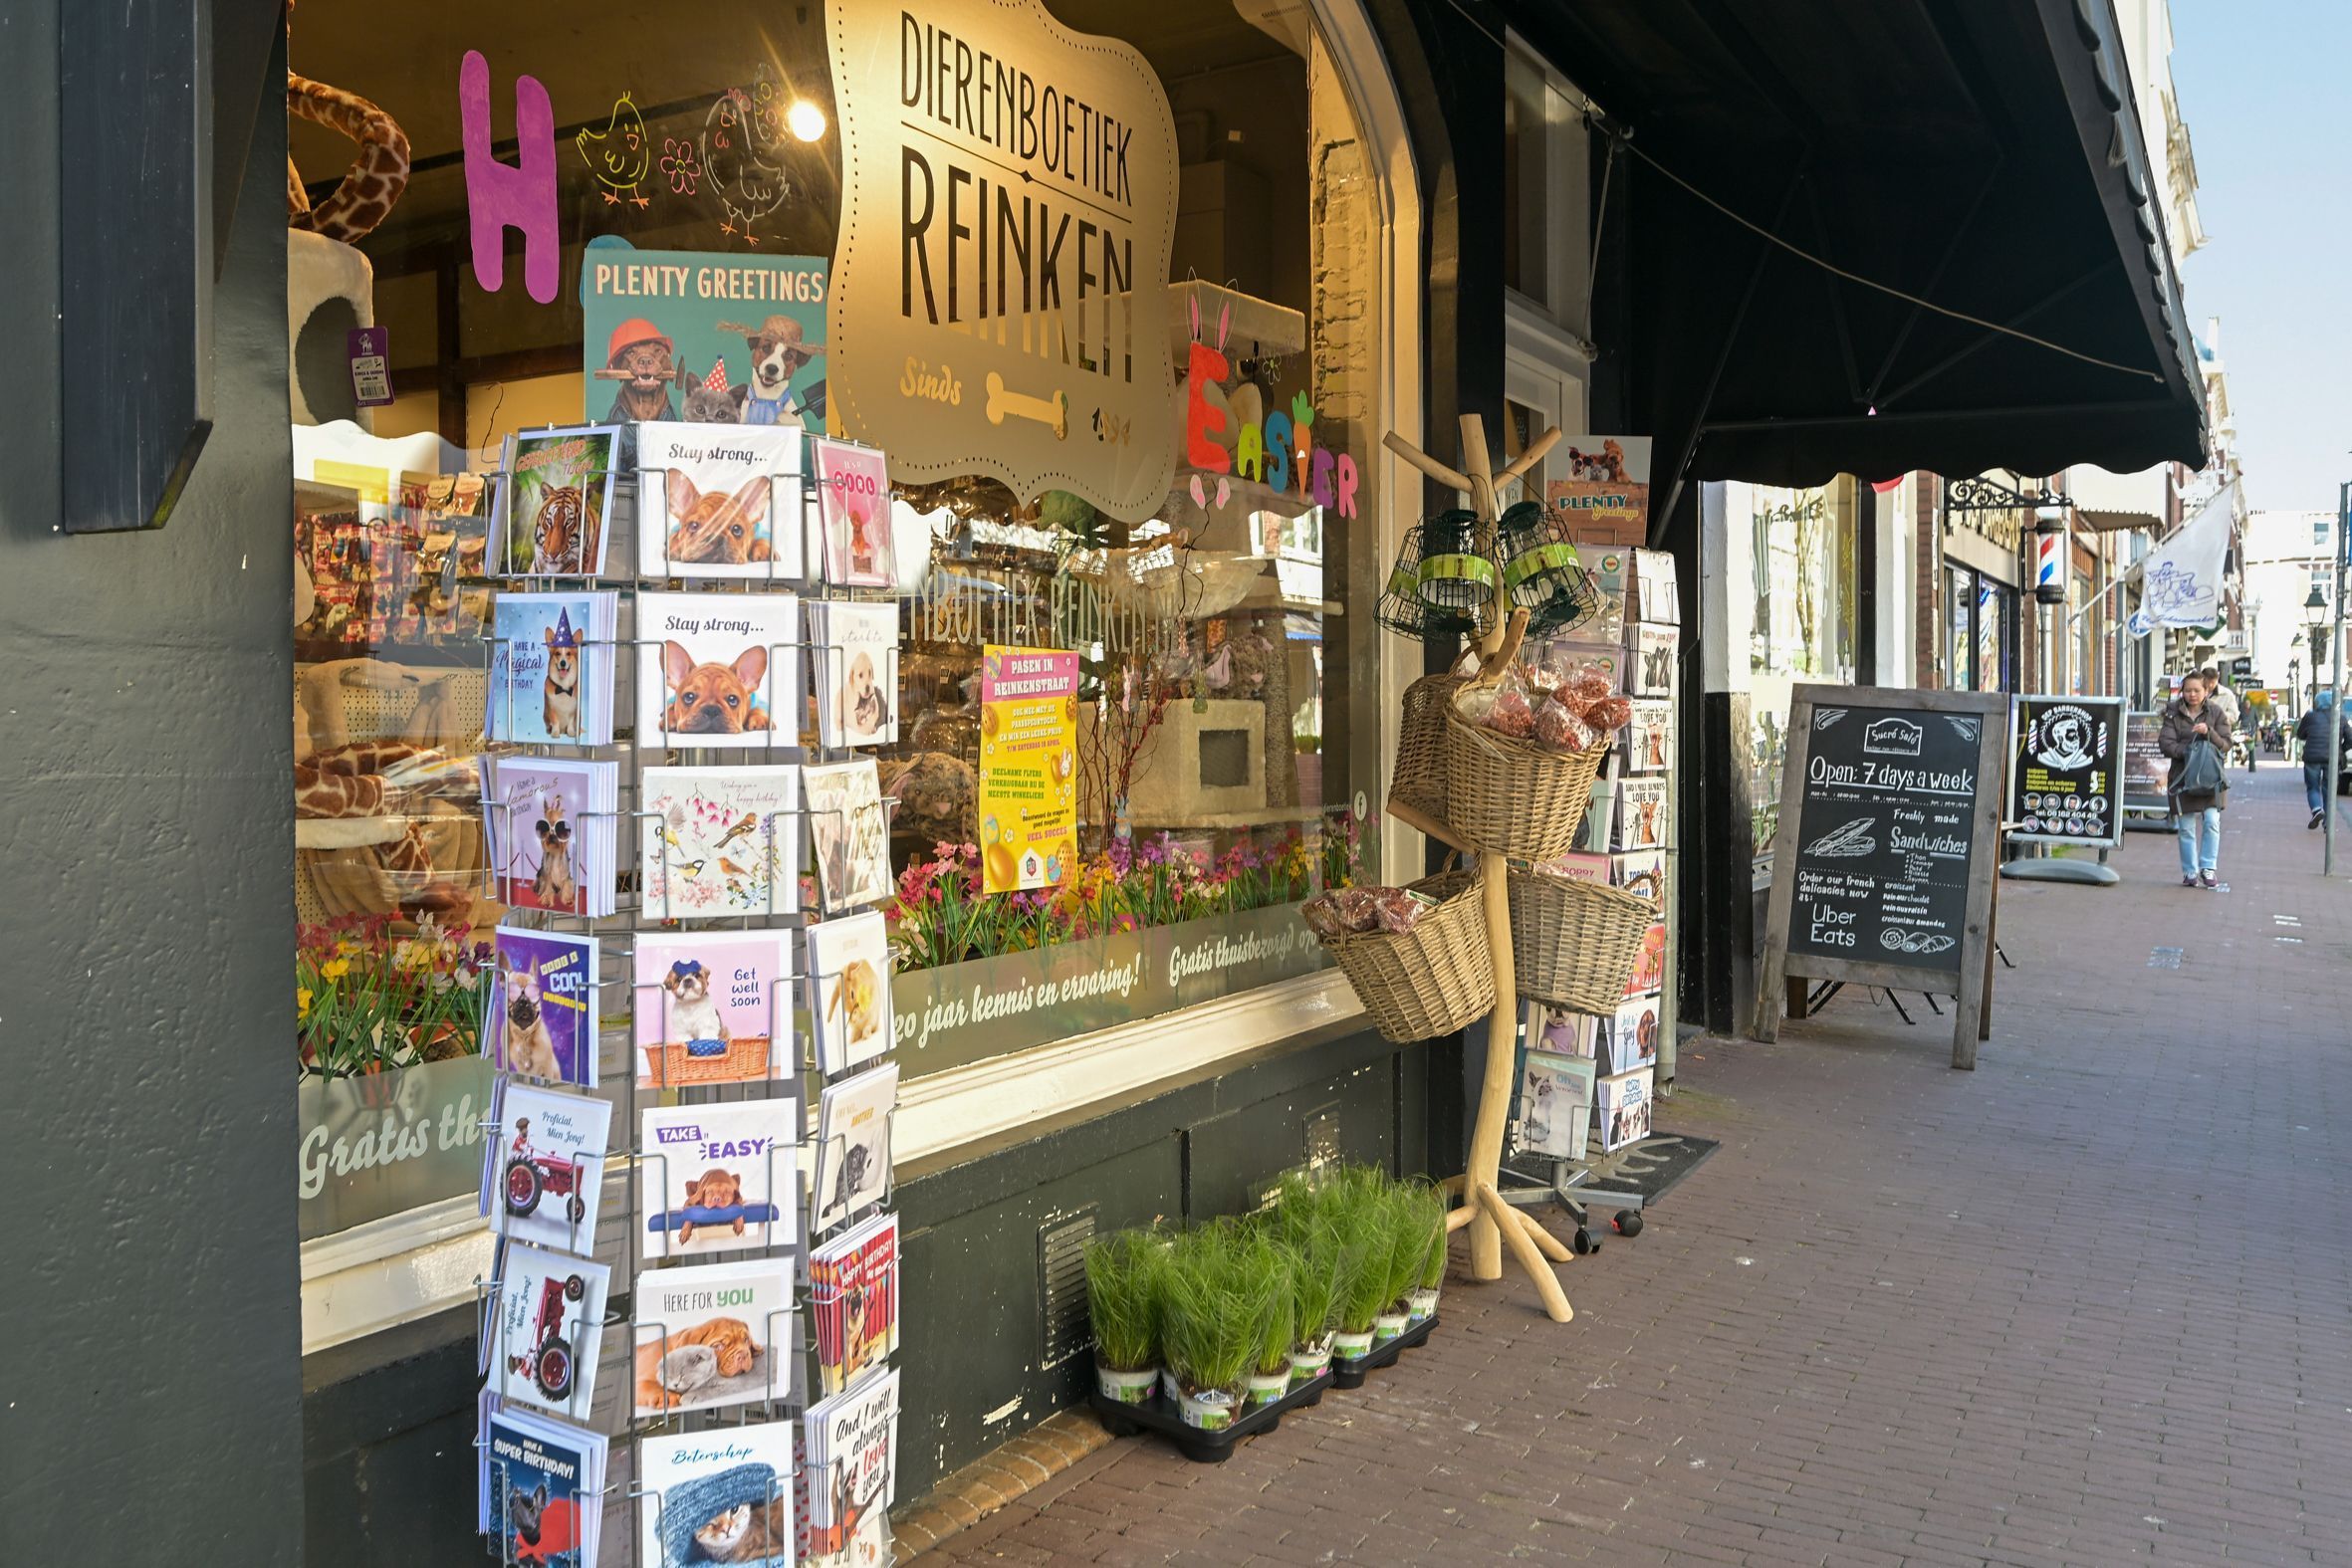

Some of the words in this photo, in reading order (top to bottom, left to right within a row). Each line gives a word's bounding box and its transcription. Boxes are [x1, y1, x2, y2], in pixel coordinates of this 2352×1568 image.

[901, 10, 1133, 207] DIERENBOETIEK
[901, 143, 1133, 383] REINKEN
[596, 264, 690, 298] PLENTY
[697, 265, 824, 303] GREETINGS
[900, 355, 962, 406] Sinds
[669, 442, 704, 465] Stay
[1559, 494, 1627, 511] PLENTY
[1591, 505, 1639, 522] Greetings
[665, 615, 701, 636] Stay
[1051, 577, 1146, 656] REINKEN
[514, 641, 528, 651] HAVE
[531, 641, 536, 651] A
[1011, 657, 1042, 675] PASEN
[1043, 657, 1055, 672] IN
[994, 677, 1070, 696] REINKENSTRAAT
[1810, 756, 1859, 789] Open:
[1862, 762, 1876, 784] 7
[1878, 764, 1915, 791] days
[1917, 770, 1928, 787] a
[1929, 769, 1975, 792] week
[1632, 792, 1647, 802] LOVE
[1648, 792, 1660, 802] YOU
[1893, 808, 1926, 824] Freshly
[1934, 814, 1960, 824] made
[1027, 832, 1043, 842] VEEL
[1045, 826, 1068, 839] SUCCES
[1890, 825, 1968, 854] Sandwiches
[1799, 871, 1823, 883] Order
[1827, 875, 1843, 884] our
[1846, 875, 1875, 888] french
[1799, 882, 1845, 896] delicacies
[1884, 882, 1916, 891] croissant
[1812, 903, 1857, 925] Uber
[1916, 918, 1946, 929] amandes
[1810, 923, 1856, 947] Eats
[1169, 942, 1214, 988] Gratis
[1215, 922, 1294, 962] thuisbezorgd
[549, 972, 587, 994] COOL
[734, 967, 756, 981] Get
[731, 981, 760, 994] well
[730, 997, 761, 1008] soon
[918, 996, 969, 1048] jaar
[971, 976, 1035, 1023] kennis
[1037, 981, 1059, 1008] en
[1060, 952, 1142, 999] ervaring!
[547, 1127, 564, 1140] Mien
[660, 1127, 698, 1142] TAKE
[299, 1107, 431, 1201] Gratis
[708, 1138, 766, 1160] EASY
[841, 1260, 863, 1287] HAPPY
[864, 1236, 894, 1271] BIRTHDAY
[664, 1294, 689, 1314] HERE
[692, 1291, 713, 1311] FOR
[836, 1409, 861, 1443] And
[863, 1402, 870, 1427] I
[870, 1388, 892, 1420] will
[851, 1414, 889, 1456] always
[522, 1439, 538, 1452] HAVE
[538, 1444, 544, 1454] A
[671, 1443, 754, 1465] Beterschap
[863, 1436, 889, 1475] love
[493, 1439, 523, 1461] SUPER
[523, 1450, 575, 1480] BIRTHDAY!
[861, 1465, 880, 1502] you
